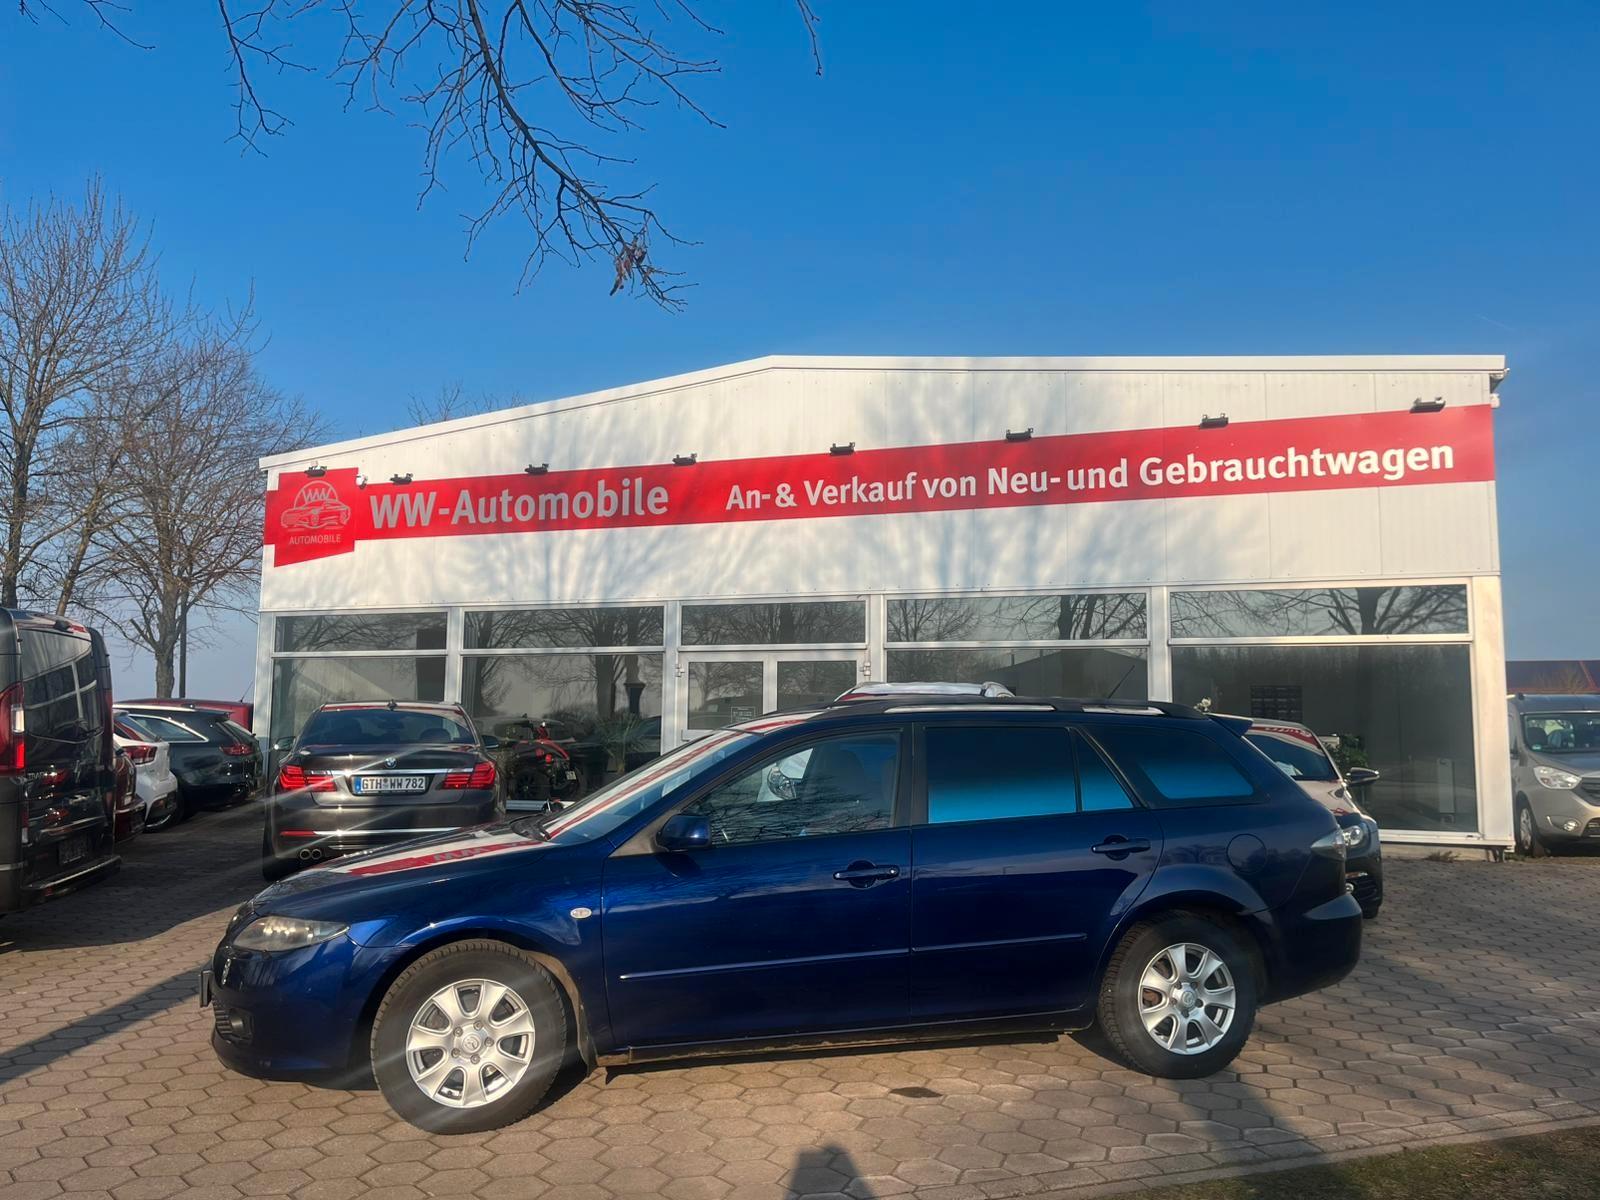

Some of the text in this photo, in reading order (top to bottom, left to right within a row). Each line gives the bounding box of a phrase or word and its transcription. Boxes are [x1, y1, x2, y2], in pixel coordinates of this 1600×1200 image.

[725, 484, 771, 510] An-
[775, 482, 797, 508] &
[803, 471, 918, 506] Verkauf
[922, 474, 976, 499] von
[1067, 458, 1128, 490] und
[1139, 444, 1454, 482] Gebrauchtwagen
[369, 476, 669, 529] WW-Automobile
[288, 533, 341, 545] AUTOMOBILE
[362, 777, 424, 789] GTH WW 782
